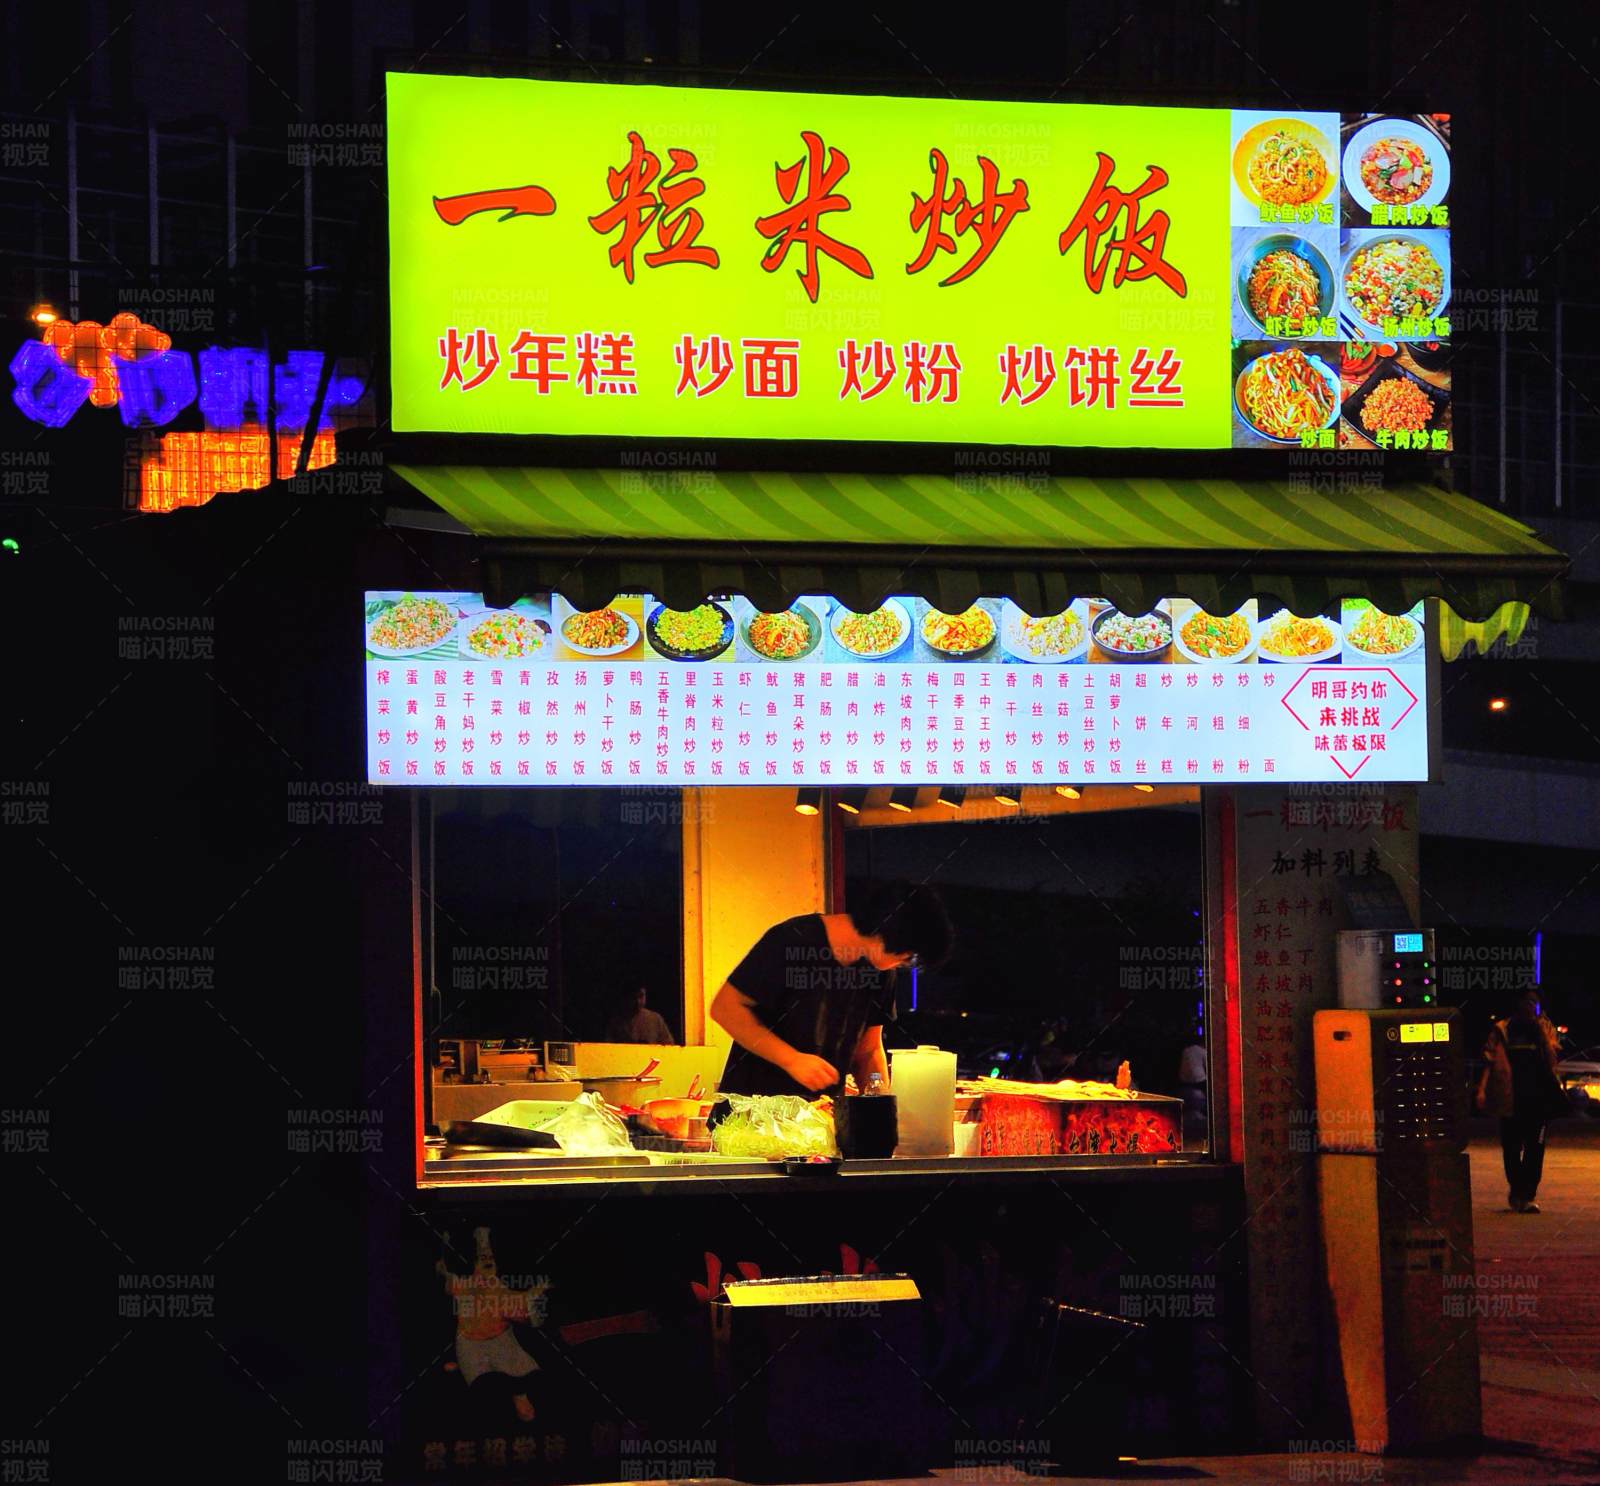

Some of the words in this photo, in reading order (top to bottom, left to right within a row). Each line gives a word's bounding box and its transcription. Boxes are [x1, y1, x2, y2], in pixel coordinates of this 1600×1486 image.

[433, 131, 1187, 303] 一粒米炒饭
[1371, 204, 1448, 225] 腊肉炒饭
[438, 329, 638, 395] 炒年糕
[674, 335, 800, 398] 炒面
[838, 340, 962, 403] 炒粉
[998, 344, 1184, 409] 炒饼丝
[1265, 317, 1337, 337] 虾仁炒饭
[1383, 317, 1450, 337] 扬州炒饭
[1301, 430, 1335, 449] 炒面
[1376, 430, 1448, 449] 牛肉炒饭
[405, 670, 419, 776] 蛋黄炒饭
[433, 669, 447, 776] 酸豆角炒饭
[461, 670, 475, 776] 老干妈炒饭
[488, 669, 503, 776] 雪菜炒饭
[517, 669, 530, 776] 青椒炒饭
[545, 671, 559, 776] 孜然炒饭
[572, 671, 587, 775] 扬州炒饭
[600, 670, 614, 775] 萝卜干炒饭
[628, 669, 643, 775] 鸭肠炒饭
[655, 671, 670, 775] 五香牛肉炒饭
[710, 671, 724, 775] 玉米粒炒饭
[737, 672, 751, 776] 虾仁炒饭
[764, 671, 779, 776] 鱿鱼炒饭
[791, 671, 805, 774] 猪耳朵炒饭
[819, 671, 833, 774] 肥肠炒饭
[846, 671, 859, 774] 腊肉炒饭
[899, 672, 912, 774] 东坡肉炒饭
[926, 672, 939, 775] 梅干菜炒饭
[951, 671, 965, 775] 四季豆炒饭
[978, 671, 991, 775] 王中王炒饭
[1004, 671, 1017, 775] 香干炒饭
[1031, 673, 1043, 774] 肉丝炒饭
[1082, 674, 1095, 774] 土豆丝炒饭
[1108, 672, 1121, 773] 胡萝卜炒饭
[1159, 674, 1172, 773] 炒年糕
[1185, 673, 1199, 773] 炒河粉
[1236, 673, 1249, 771] 炒细粉
[1263, 673, 1275, 772] 炒面
[1311, 681, 1387, 699] 明哥约你
[1319, 706, 1380, 727] 来挑战
[1314, 733, 1387, 752] 味蕾极限
[1272, 848, 1382, 877] 加料列表
